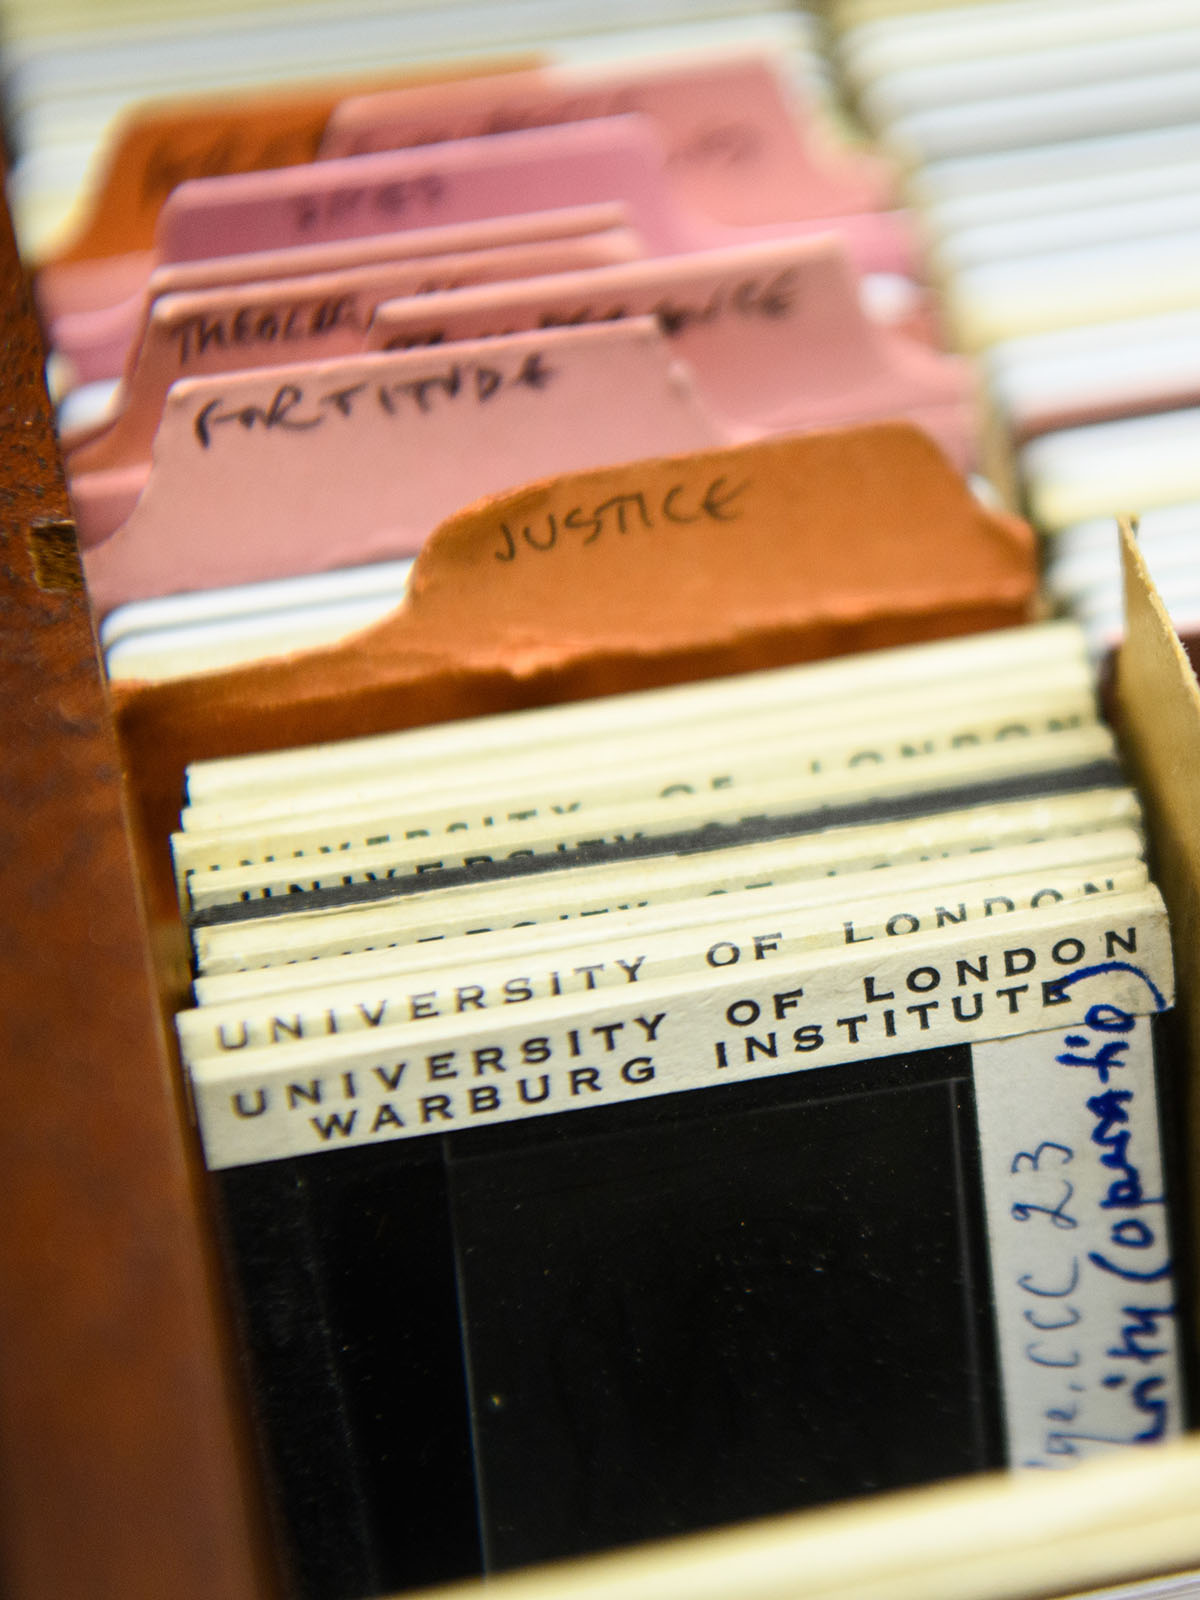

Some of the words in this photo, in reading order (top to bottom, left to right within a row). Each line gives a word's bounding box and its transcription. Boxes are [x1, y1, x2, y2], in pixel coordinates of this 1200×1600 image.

[194, 352, 557, 447] FORTITUDE
[495, 475, 754, 562] JUSTICE
[217, 956, 647, 1051] UNIVERSITY
[705, 932, 783, 968] OF
[843, 878, 1115, 945] LONDON
[231, 1013, 668, 1118] UNIVERSITY
[726, 988, 804, 1027] OF
[863, 926, 1138, 1004] LONDON
[310, 1056, 657, 1141] WARBURG
[714, 978, 1072, 1068] INSTITUTE
[1011, 1140, 1078, 1230] 23
